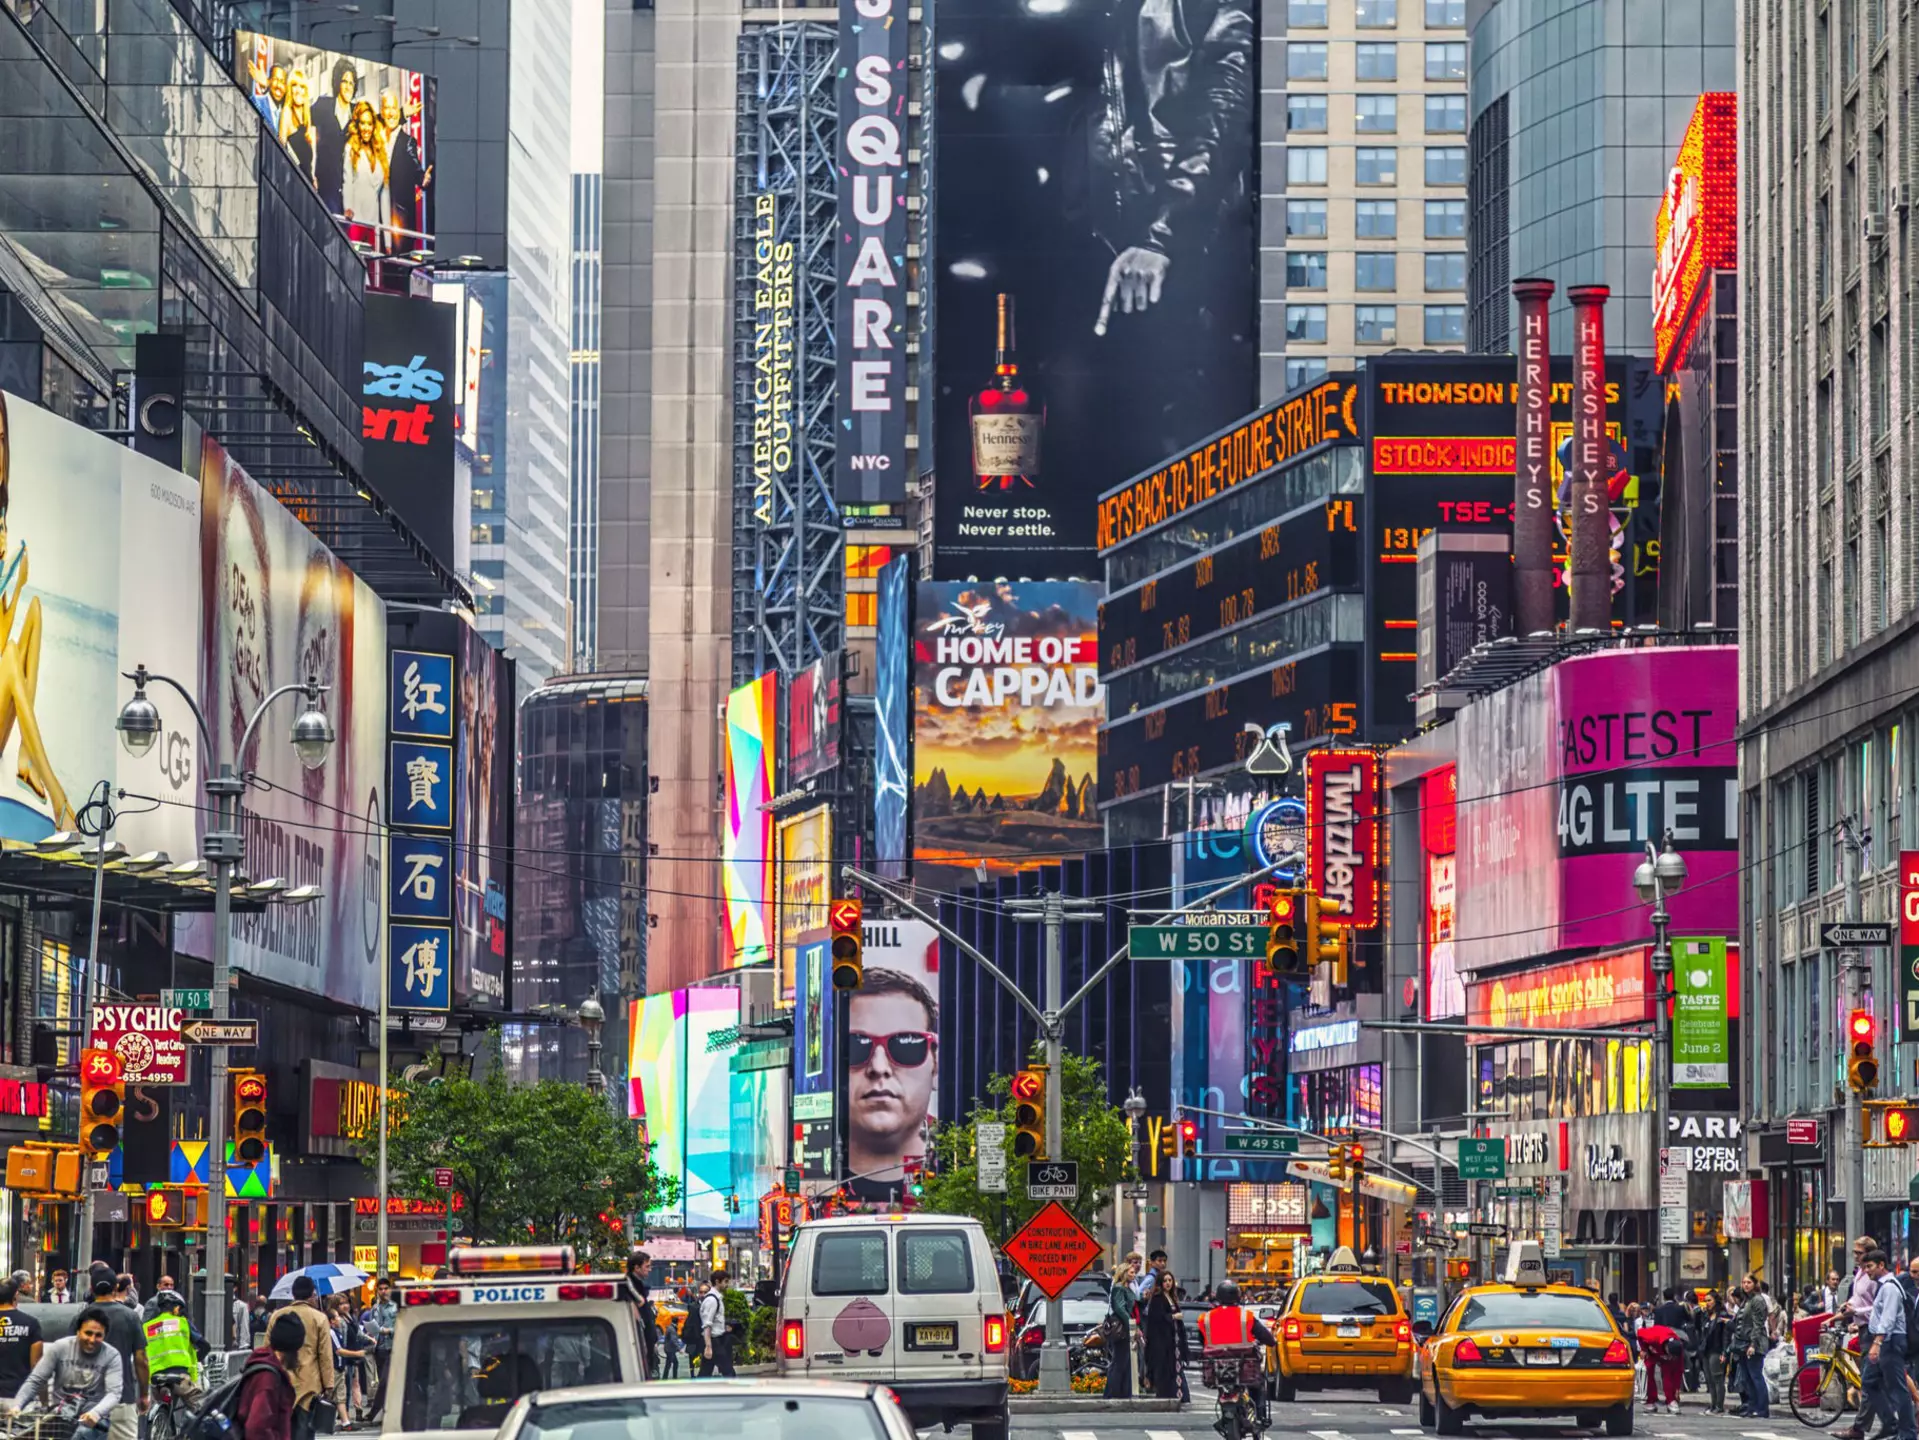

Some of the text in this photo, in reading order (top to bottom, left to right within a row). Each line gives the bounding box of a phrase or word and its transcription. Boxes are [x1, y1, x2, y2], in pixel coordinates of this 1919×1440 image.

[754, 194, 774, 525] AMERICAN EAGLE
[774, 241, 793, 472] OUTFITTERS
[1380, 383, 1503, 404] THOMSON
[1526, 315, 1542, 508] HERSHEYS
[1581, 323, 1598, 514] HERSHEYS
[851, 455, 891, 471] NYC
[1380, 445, 1453, 467] STOCK
[964, 506, 1051, 520] Never stop.
[958, 524, 1056, 536] Never settle.
[1477, 581, 1487, 620] COCOA
[937, 637, 1082, 664] HOME OF
[159, 731, 191, 790] UGG
[1558, 780, 1700, 848] 4G LTE
[862, 927, 902, 947] HILL
[1159, 932, 1255, 953] W 50 St
[1833, 931, 1883, 940] ONE WAY
[175, 992, 184, 1007] W
[188, 992, 200, 1007] 50
[1508, 992, 1527, 1021] new
[1528, 977, 1551, 1027] york
[1551, 968, 1583, 1023] sports
[1585, 966, 1614, 1009] clubs
[1680, 995, 1720, 1005] TASTE
[92, 1006, 183, 1032] PSYCHIC
[1680, 1019, 1720, 1028] Celebrate
[195, 1027, 248, 1038] ONE WAY
[1680, 1043, 1721, 1054] June 2
[156, 1053, 181, 1068] Readings
[1239, 1139, 1285, 1149] W 49 St
[1694, 1147, 1735, 1160] OPEN
[1694, 1159, 1711, 1171] 24
[1033, 1186, 1075, 1196] BIKE PATH
[1027, 1228, 1078, 1237] CONSTRUCTION
[1020, 1241, 1087, 1251] IN BIKE LANE AHEAD
[1028, 1254, 1078, 1263] PROCEED WITH
[1038, 1267, 1068, 1277] CAUTION
[473, 1288, 545, 1303] POLICE
[5, 1326, 29, 1337] TEAM
